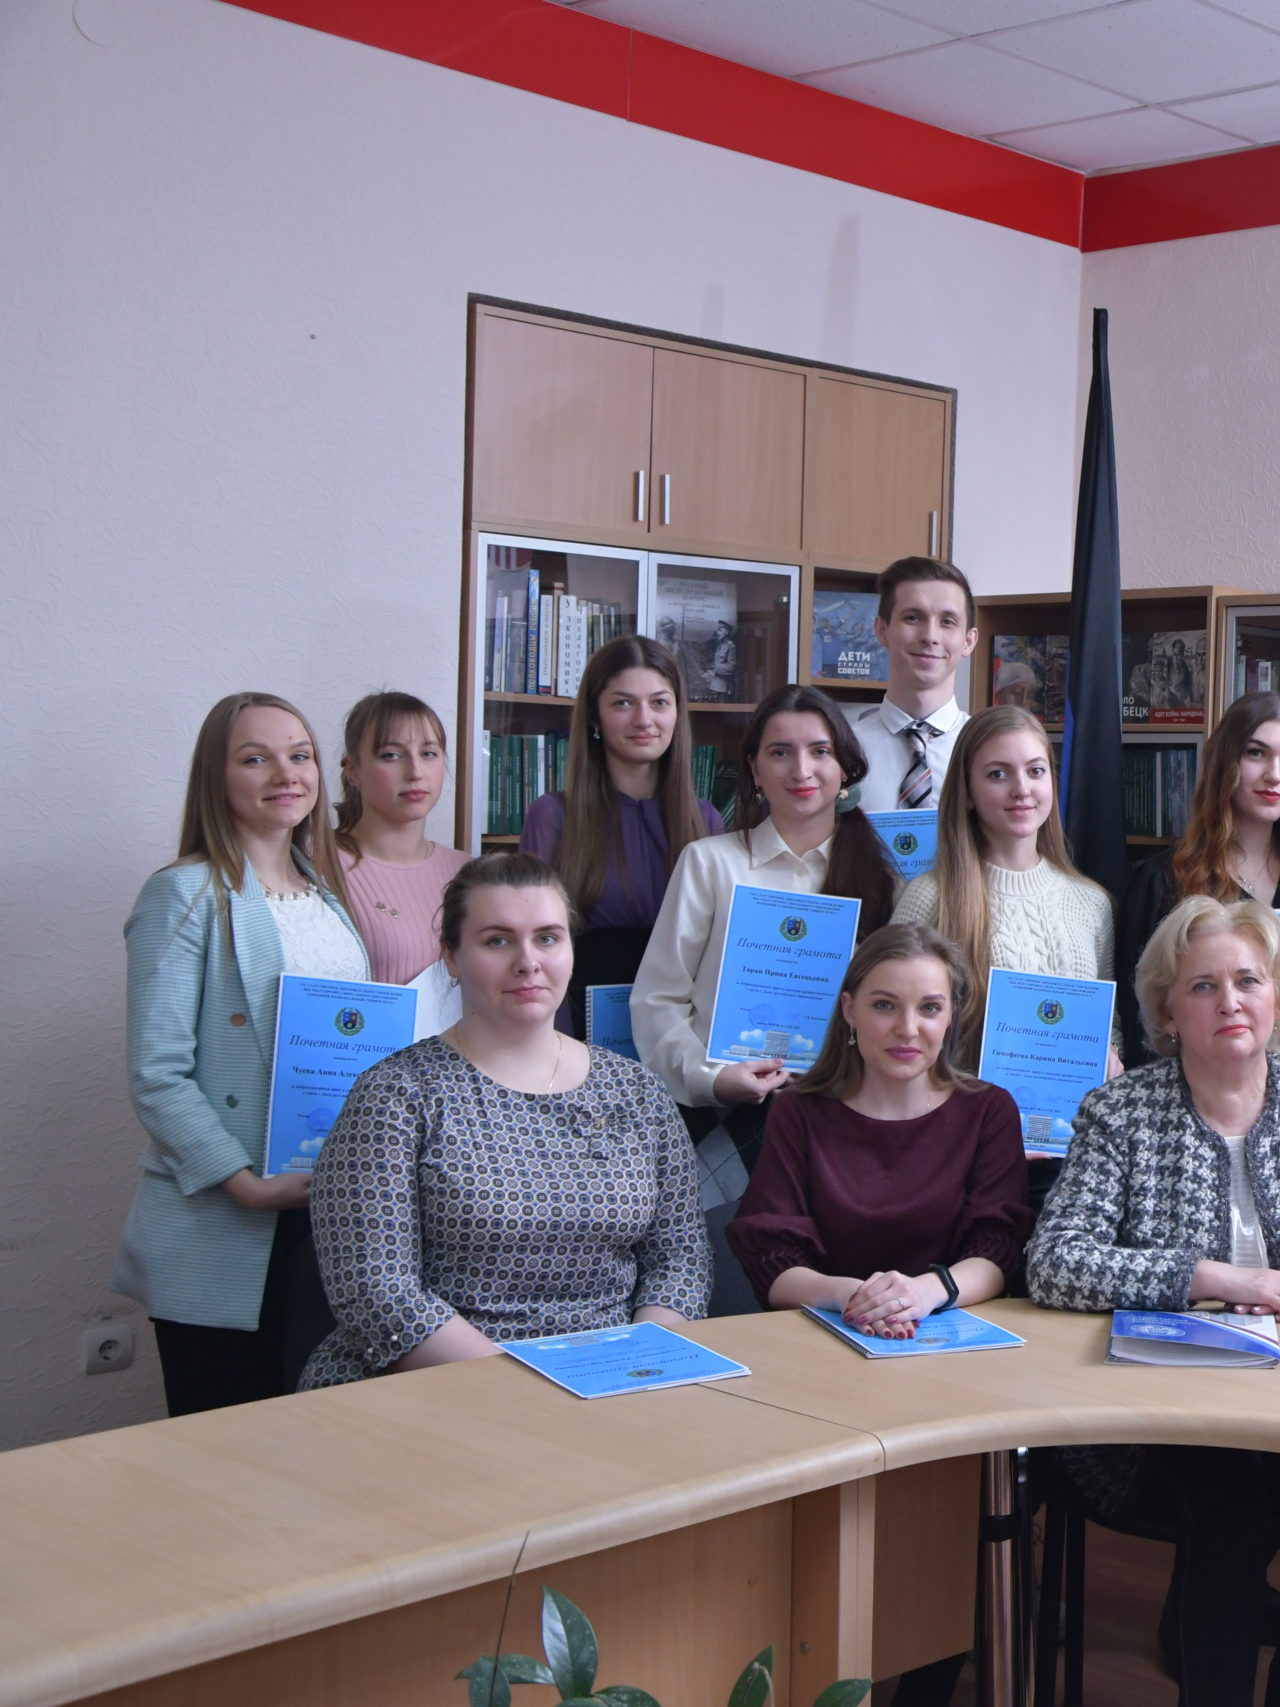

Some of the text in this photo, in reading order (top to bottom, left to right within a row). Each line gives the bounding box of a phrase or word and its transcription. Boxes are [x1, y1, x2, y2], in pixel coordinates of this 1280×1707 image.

[838, 651, 871, 662] ДЕТИ
[1121, 696, 1134, 705] ЛО
[1123, 706, 1149, 718] БЕЦК
[736, 937, 842, 960] Почетная грамота
[996, 1022, 1099, 1043] Почетная грамота
[289, 1034, 349, 1051] Почетная
